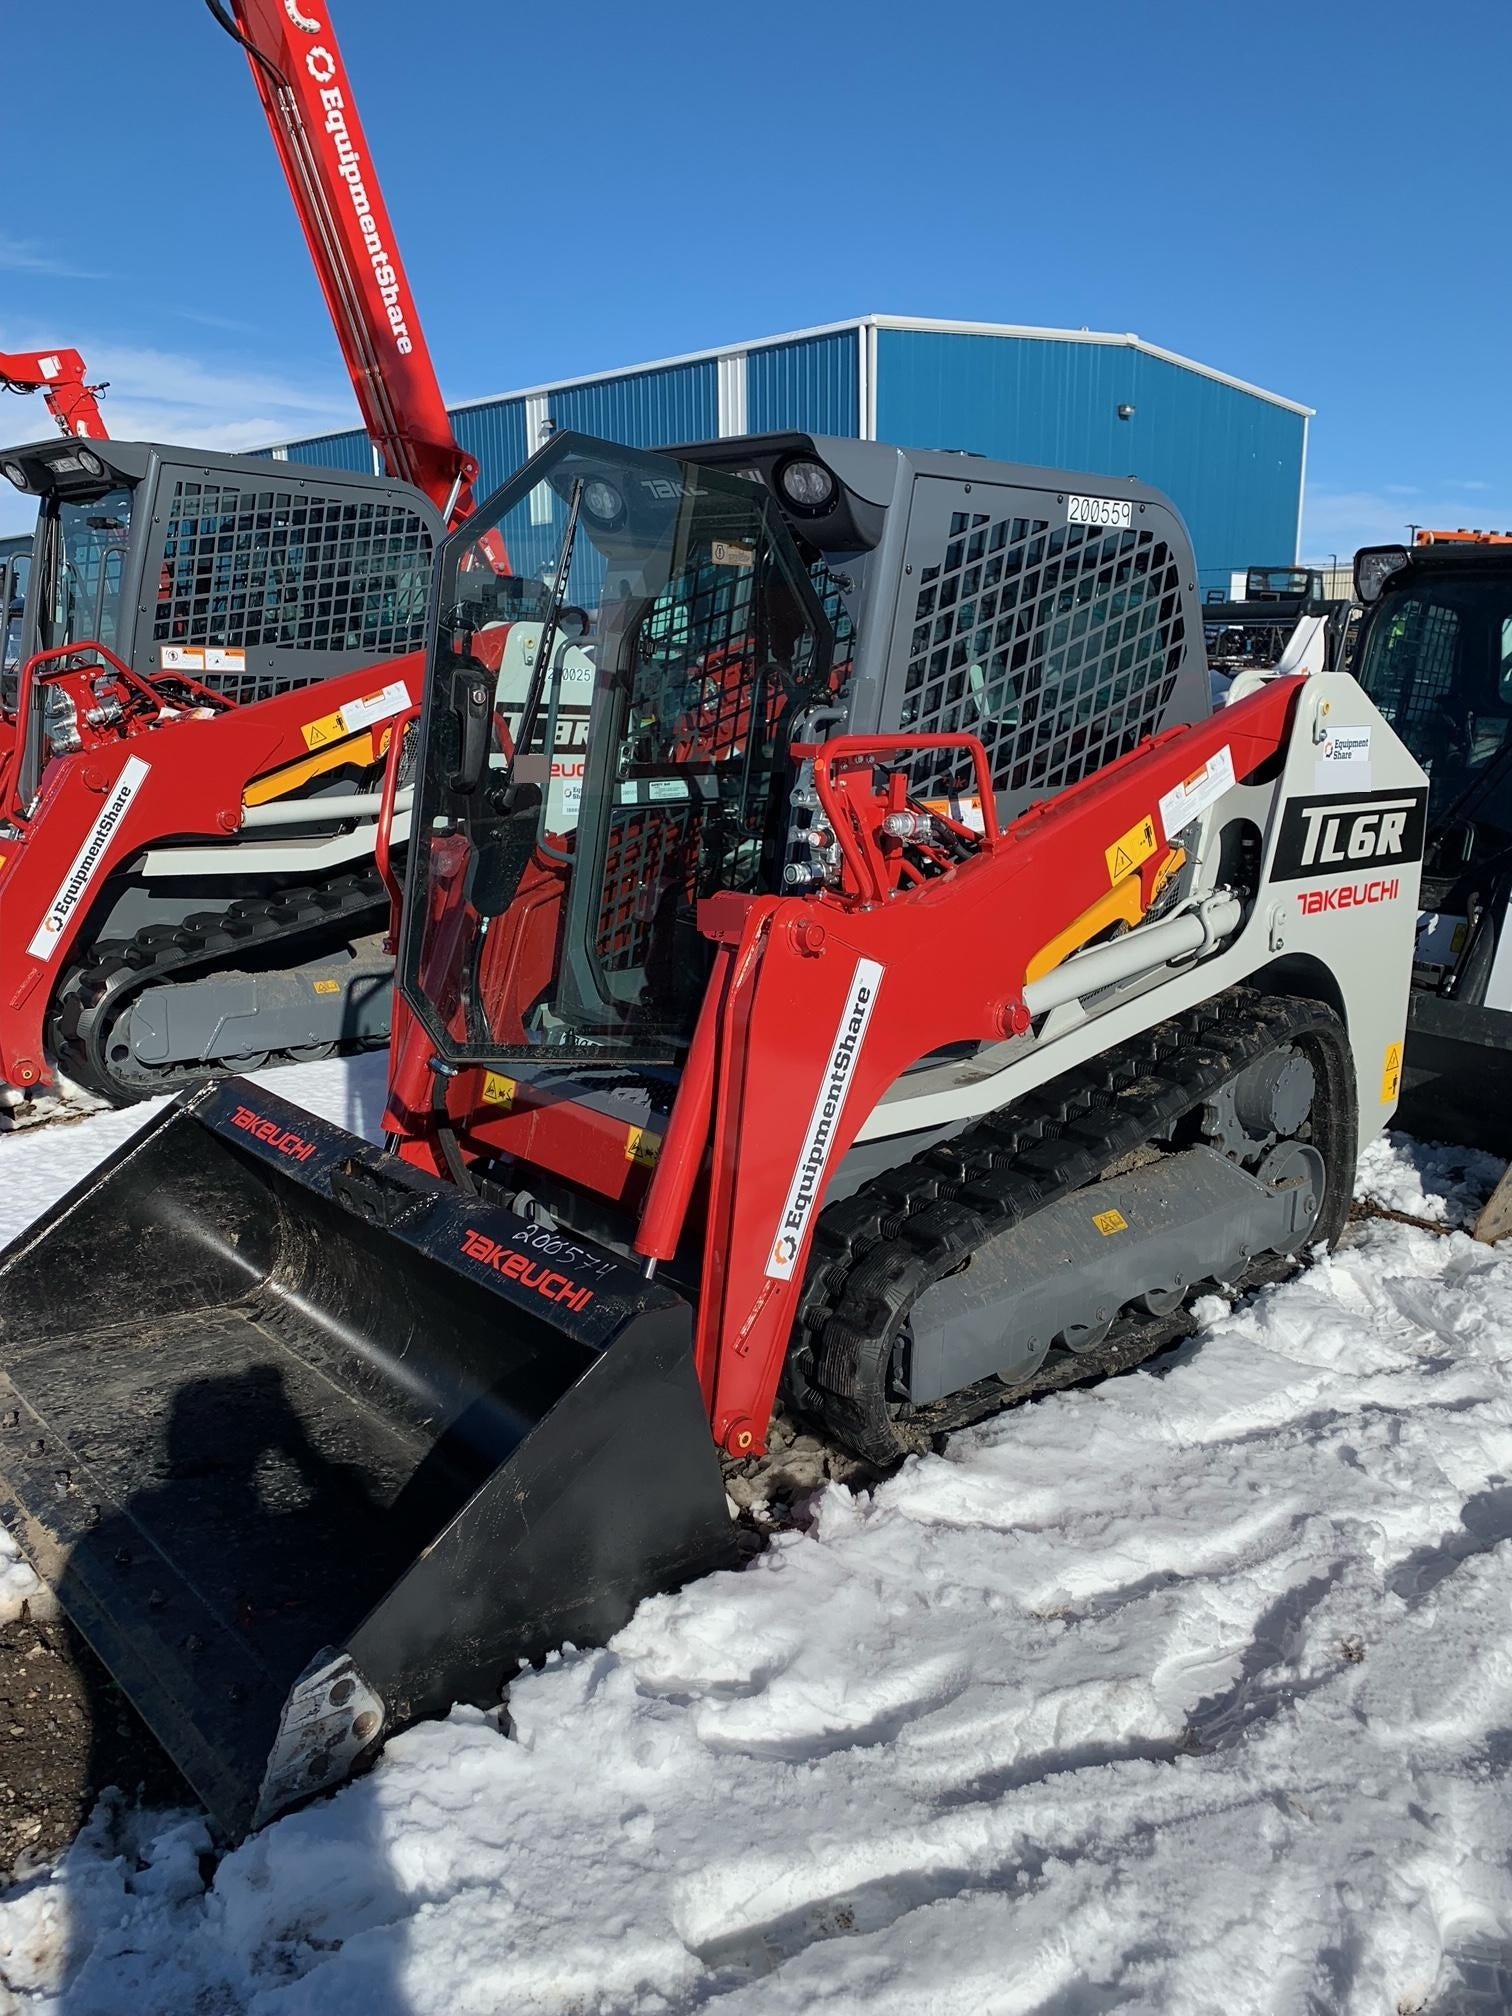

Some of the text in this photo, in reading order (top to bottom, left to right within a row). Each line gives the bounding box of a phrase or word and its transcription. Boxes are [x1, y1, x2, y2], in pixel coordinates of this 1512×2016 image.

[320, 86, 412, 355] EquipmentShare
[1069, 497, 1131, 526] 200559
[1333, 749, 1352, 760] Share
[1334, 738, 1369, 750] Equipment
[55, 784, 133, 917] EquipmentShare
[1300, 798, 1417, 866] TL6R
[1297, 879, 1399, 915] TAKEUCHI
[230, 1105, 316, 1162] TAKEUCHI
[785, 986, 871, 1231] EquipmentShare
[459, 1228, 594, 1312] TAKEUCHI
